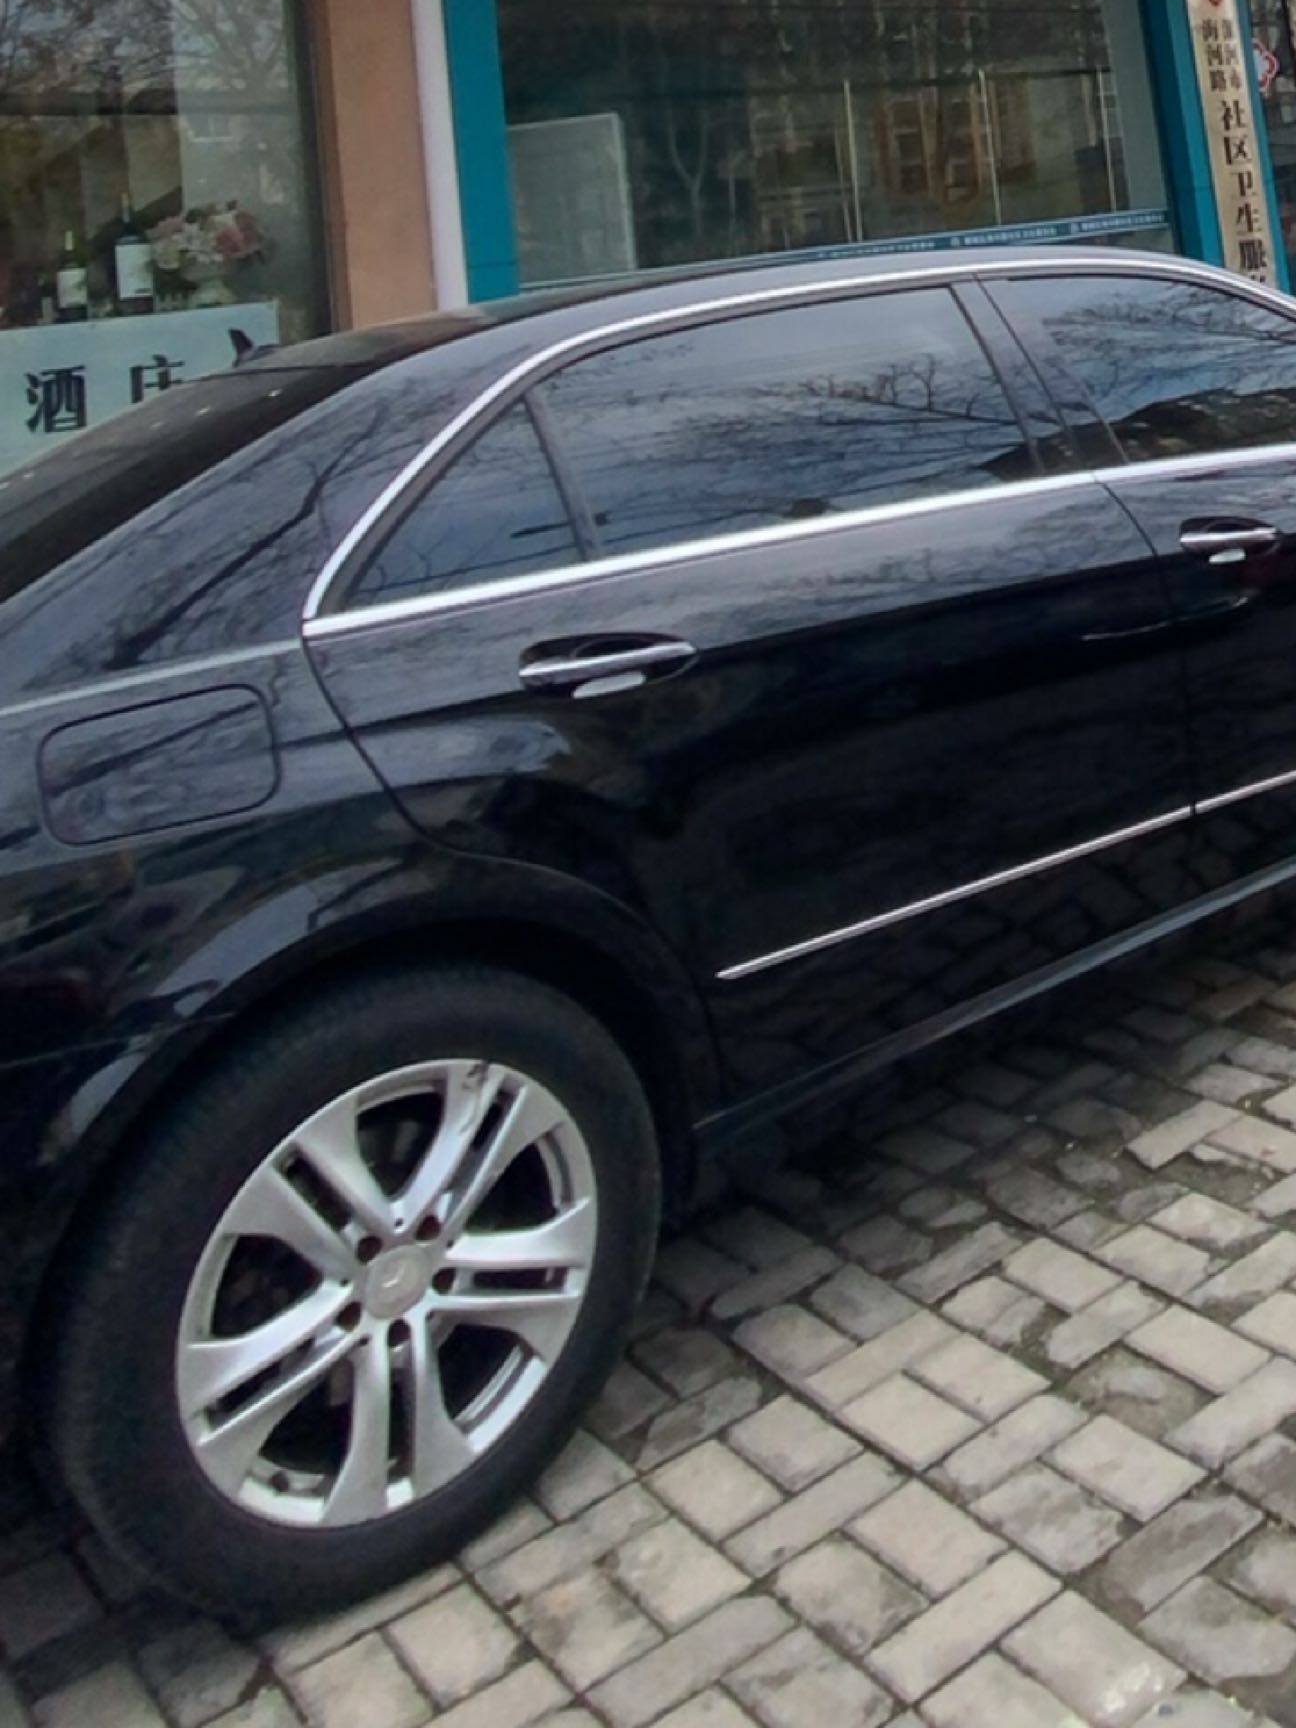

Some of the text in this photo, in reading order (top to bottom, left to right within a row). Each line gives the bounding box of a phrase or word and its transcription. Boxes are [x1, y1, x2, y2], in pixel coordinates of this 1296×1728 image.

[1219, 100, 1268, 283] 社区卫生服
